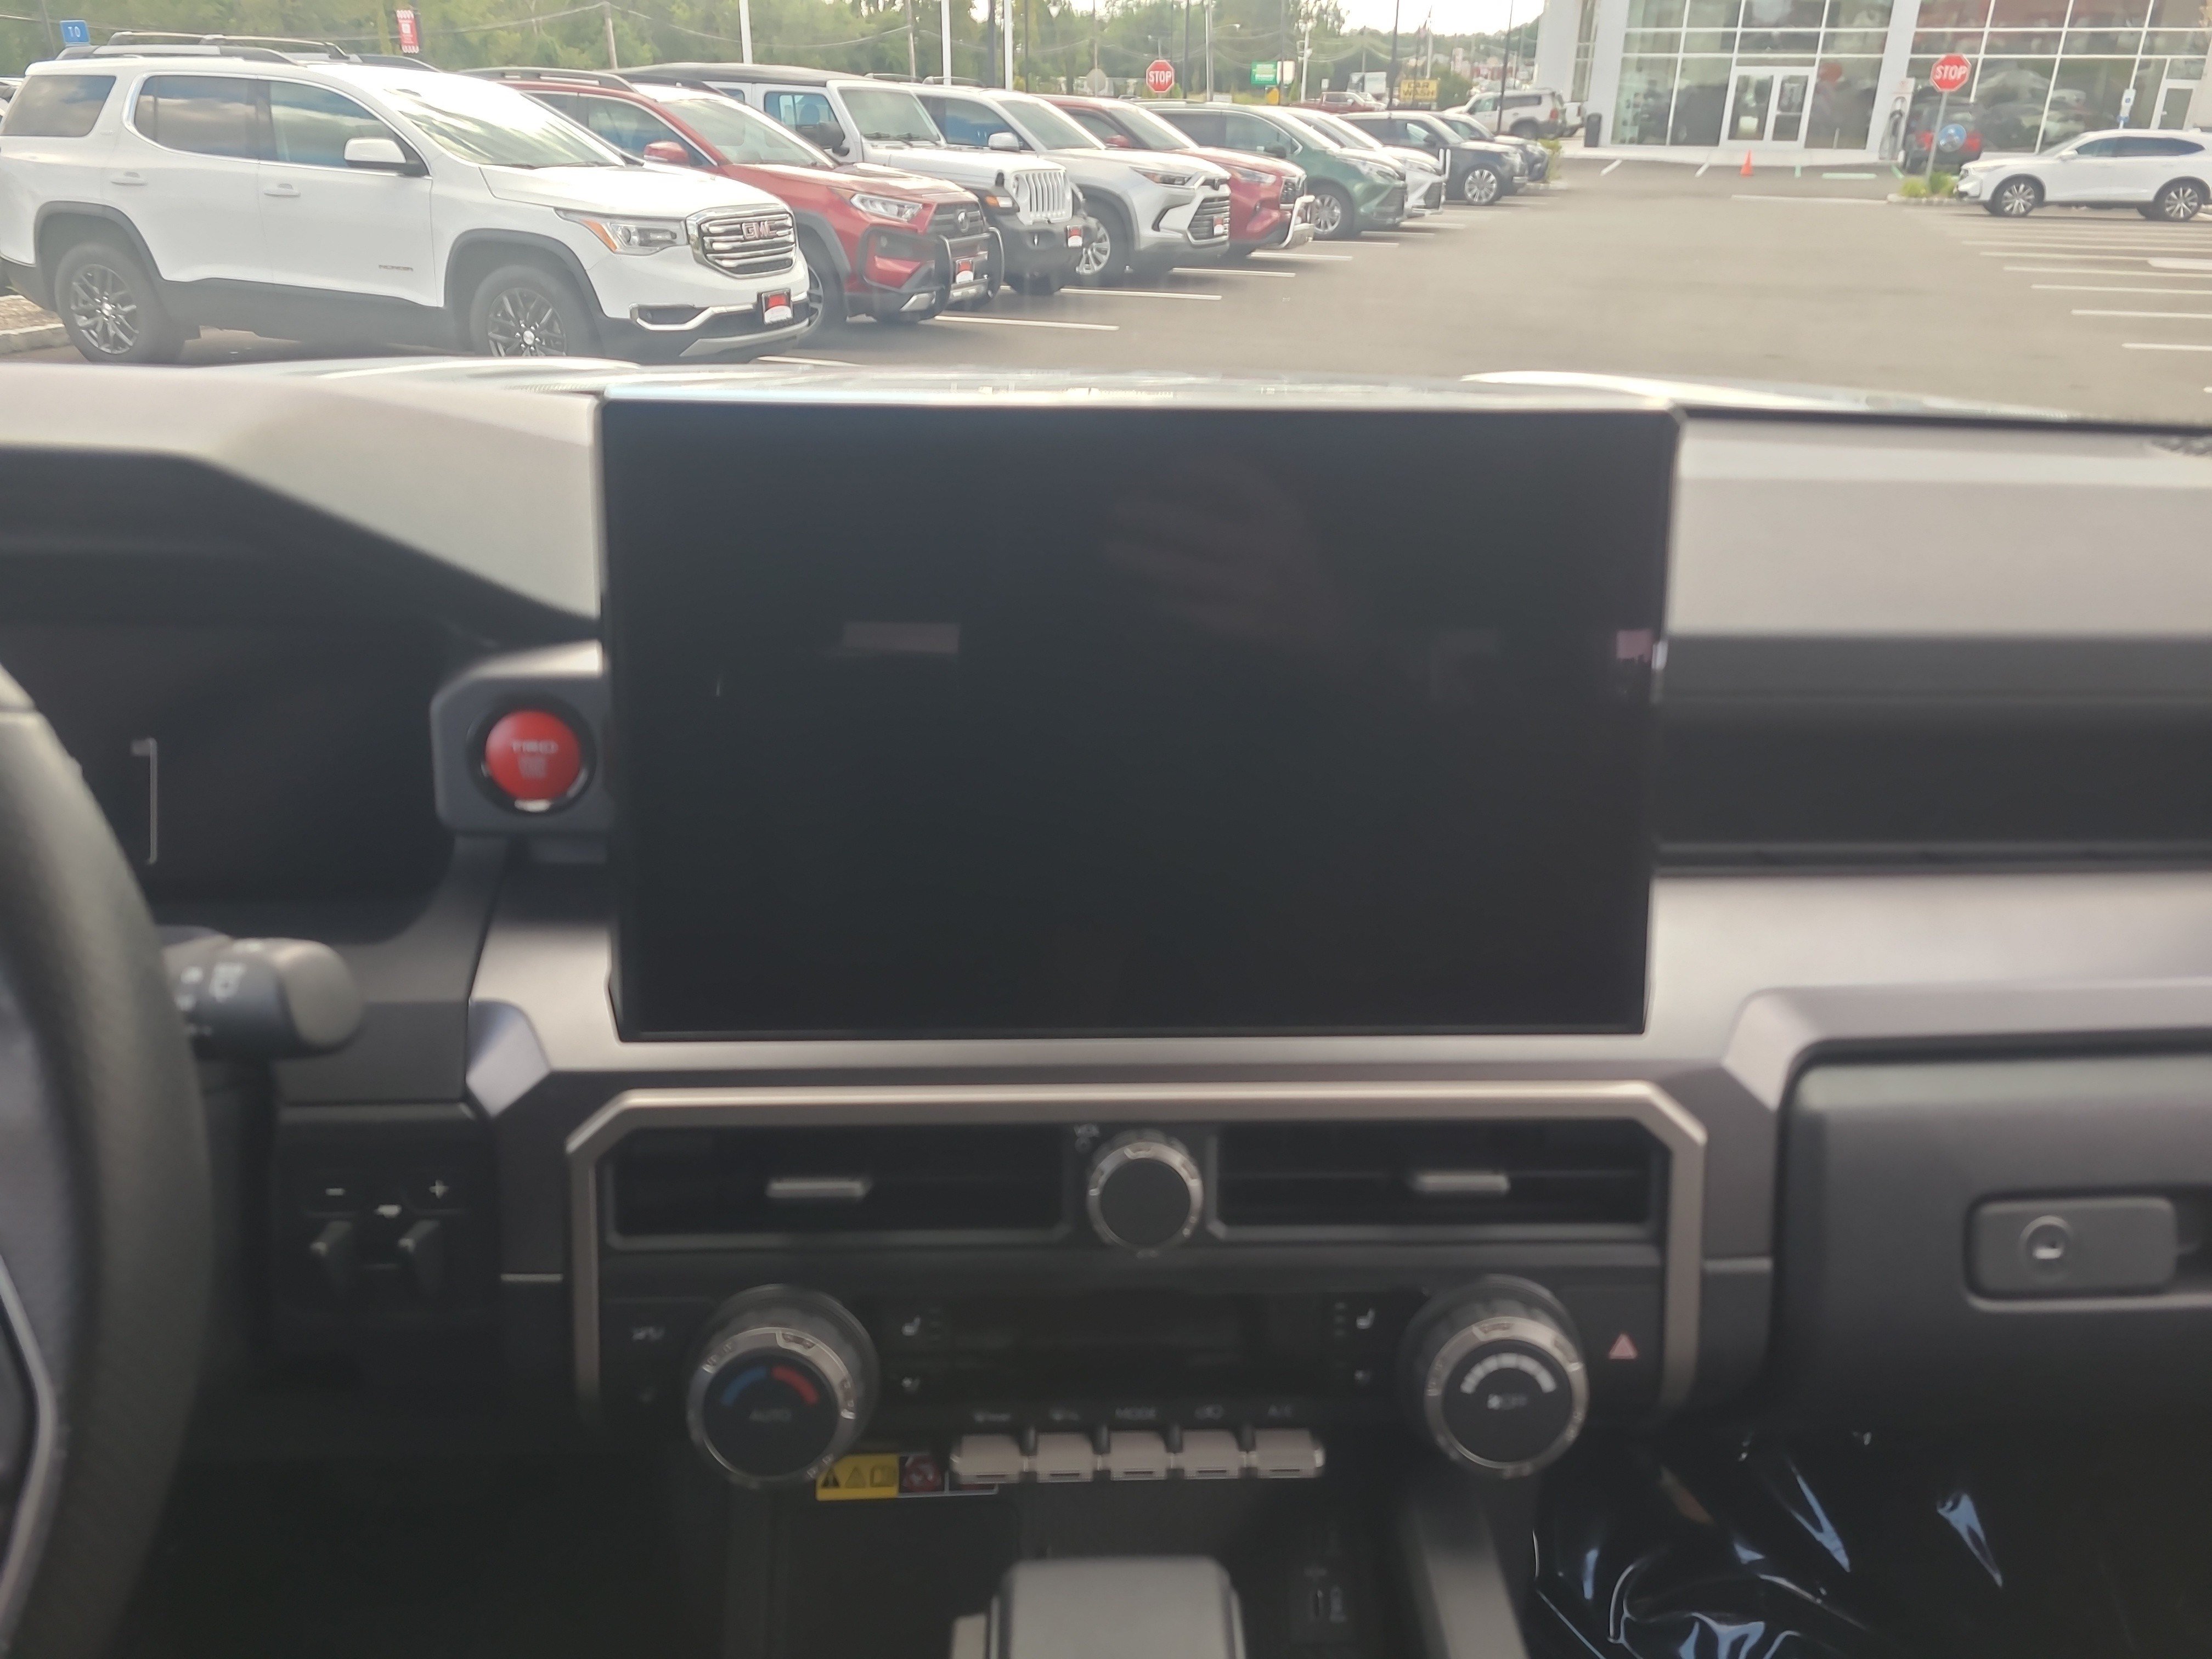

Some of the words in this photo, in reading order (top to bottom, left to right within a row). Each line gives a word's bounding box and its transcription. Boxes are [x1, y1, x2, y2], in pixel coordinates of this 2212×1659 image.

[1149, 70, 1172, 84] STOP
[1934, 65, 1967, 81] STOP
[742, 221, 777, 239] GMC
